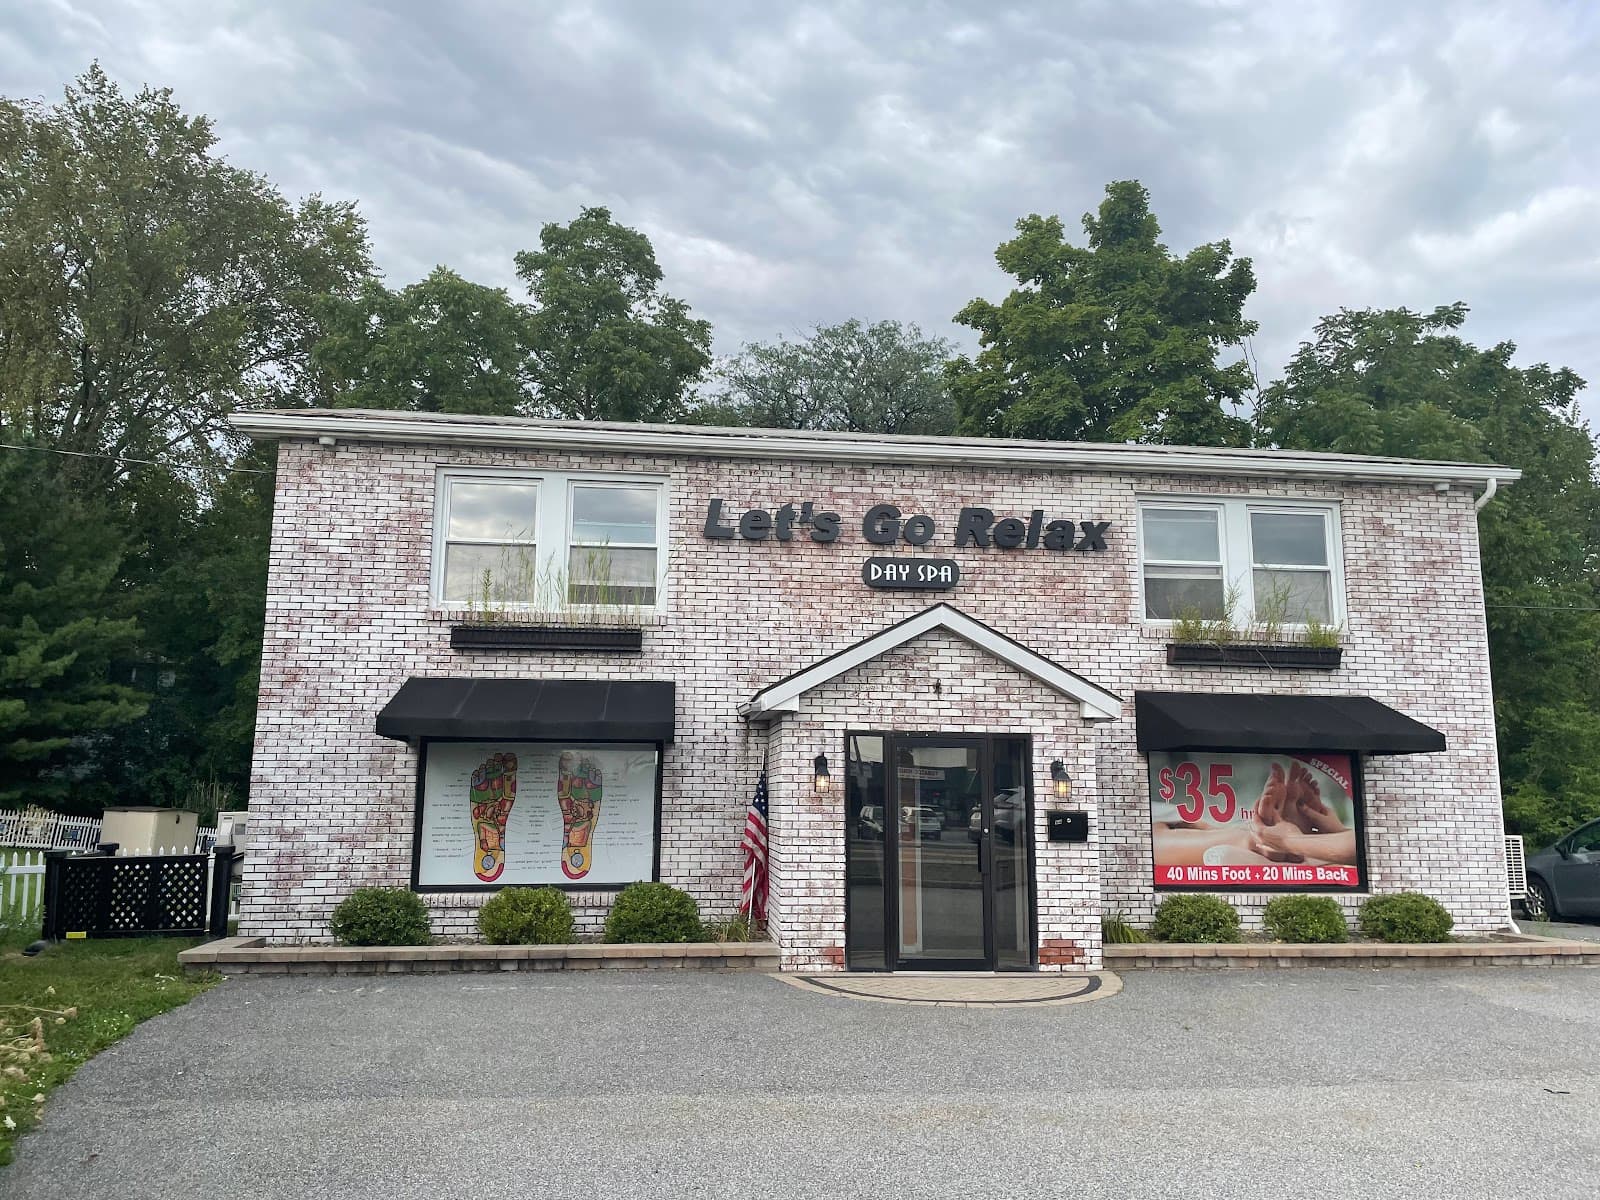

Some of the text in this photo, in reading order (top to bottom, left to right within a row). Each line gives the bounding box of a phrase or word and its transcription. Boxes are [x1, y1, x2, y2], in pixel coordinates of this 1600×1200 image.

[703, 498, 1112, 552] Let's Go Relax
[869, 563, 953, 583] DAY SPA
[1309, 757, 1350, 791] SPECIAL
[1158, 761, 1237, 824] $35
[1167, 867, 1183, 881] 40
[1187, 867, 1218, 881] Mins
[1221, 867, 1251, 881] Foot
[1262, 867, 1279, 881] 20
[1282, 867, 1313, 881] Mins
[1316, 867, 1349, 882] Back
